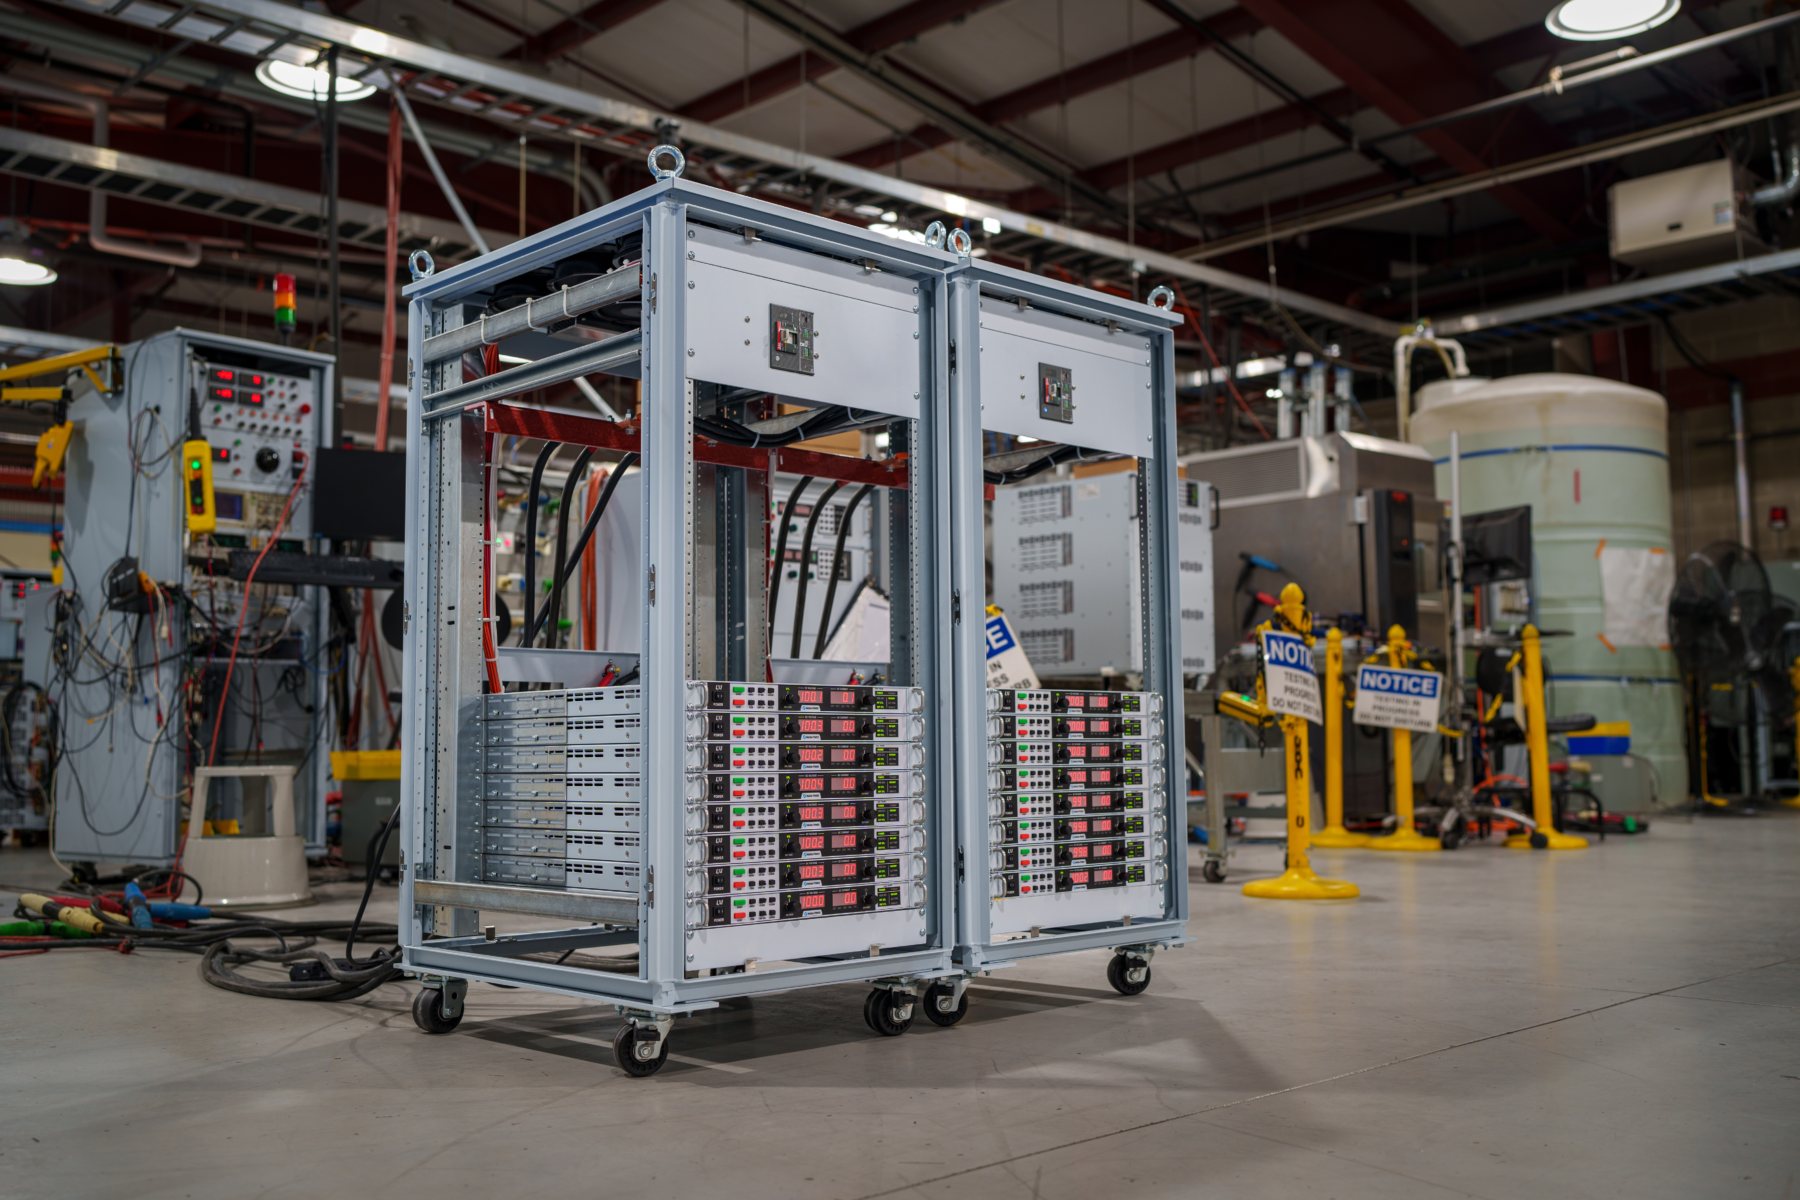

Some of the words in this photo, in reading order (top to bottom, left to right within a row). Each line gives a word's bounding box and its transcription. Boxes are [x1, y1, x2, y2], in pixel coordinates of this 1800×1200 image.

[989, 660, 1002, 673] IN
[1363, 670, 1435, 695] NOTICE
[801, 691, 822, 702] 100.1
[1374, 694, 1410, 705] TESTING
[1272, 696, 1285, 707] DO
[1287, 701, 1302, 711] NOT
[1373, 704, 1420, 716] PROGRESS
[1360, 712, 1372, 720] DO
[1374, 714, 1392, 722] NOT
[1394, 716, 1432, 727] DISTURB
[802, 720, 823, 731] 100.3
[802, 750, 823, 760] 100.2
[802, 779, 823, 790] 100.4
[802, 808, 824, 819] 100.3
[802, 837, 824, 848] 100.2
[803, 866, 824, 878] 100.3
[803, 895, 825, 907] 100.0
